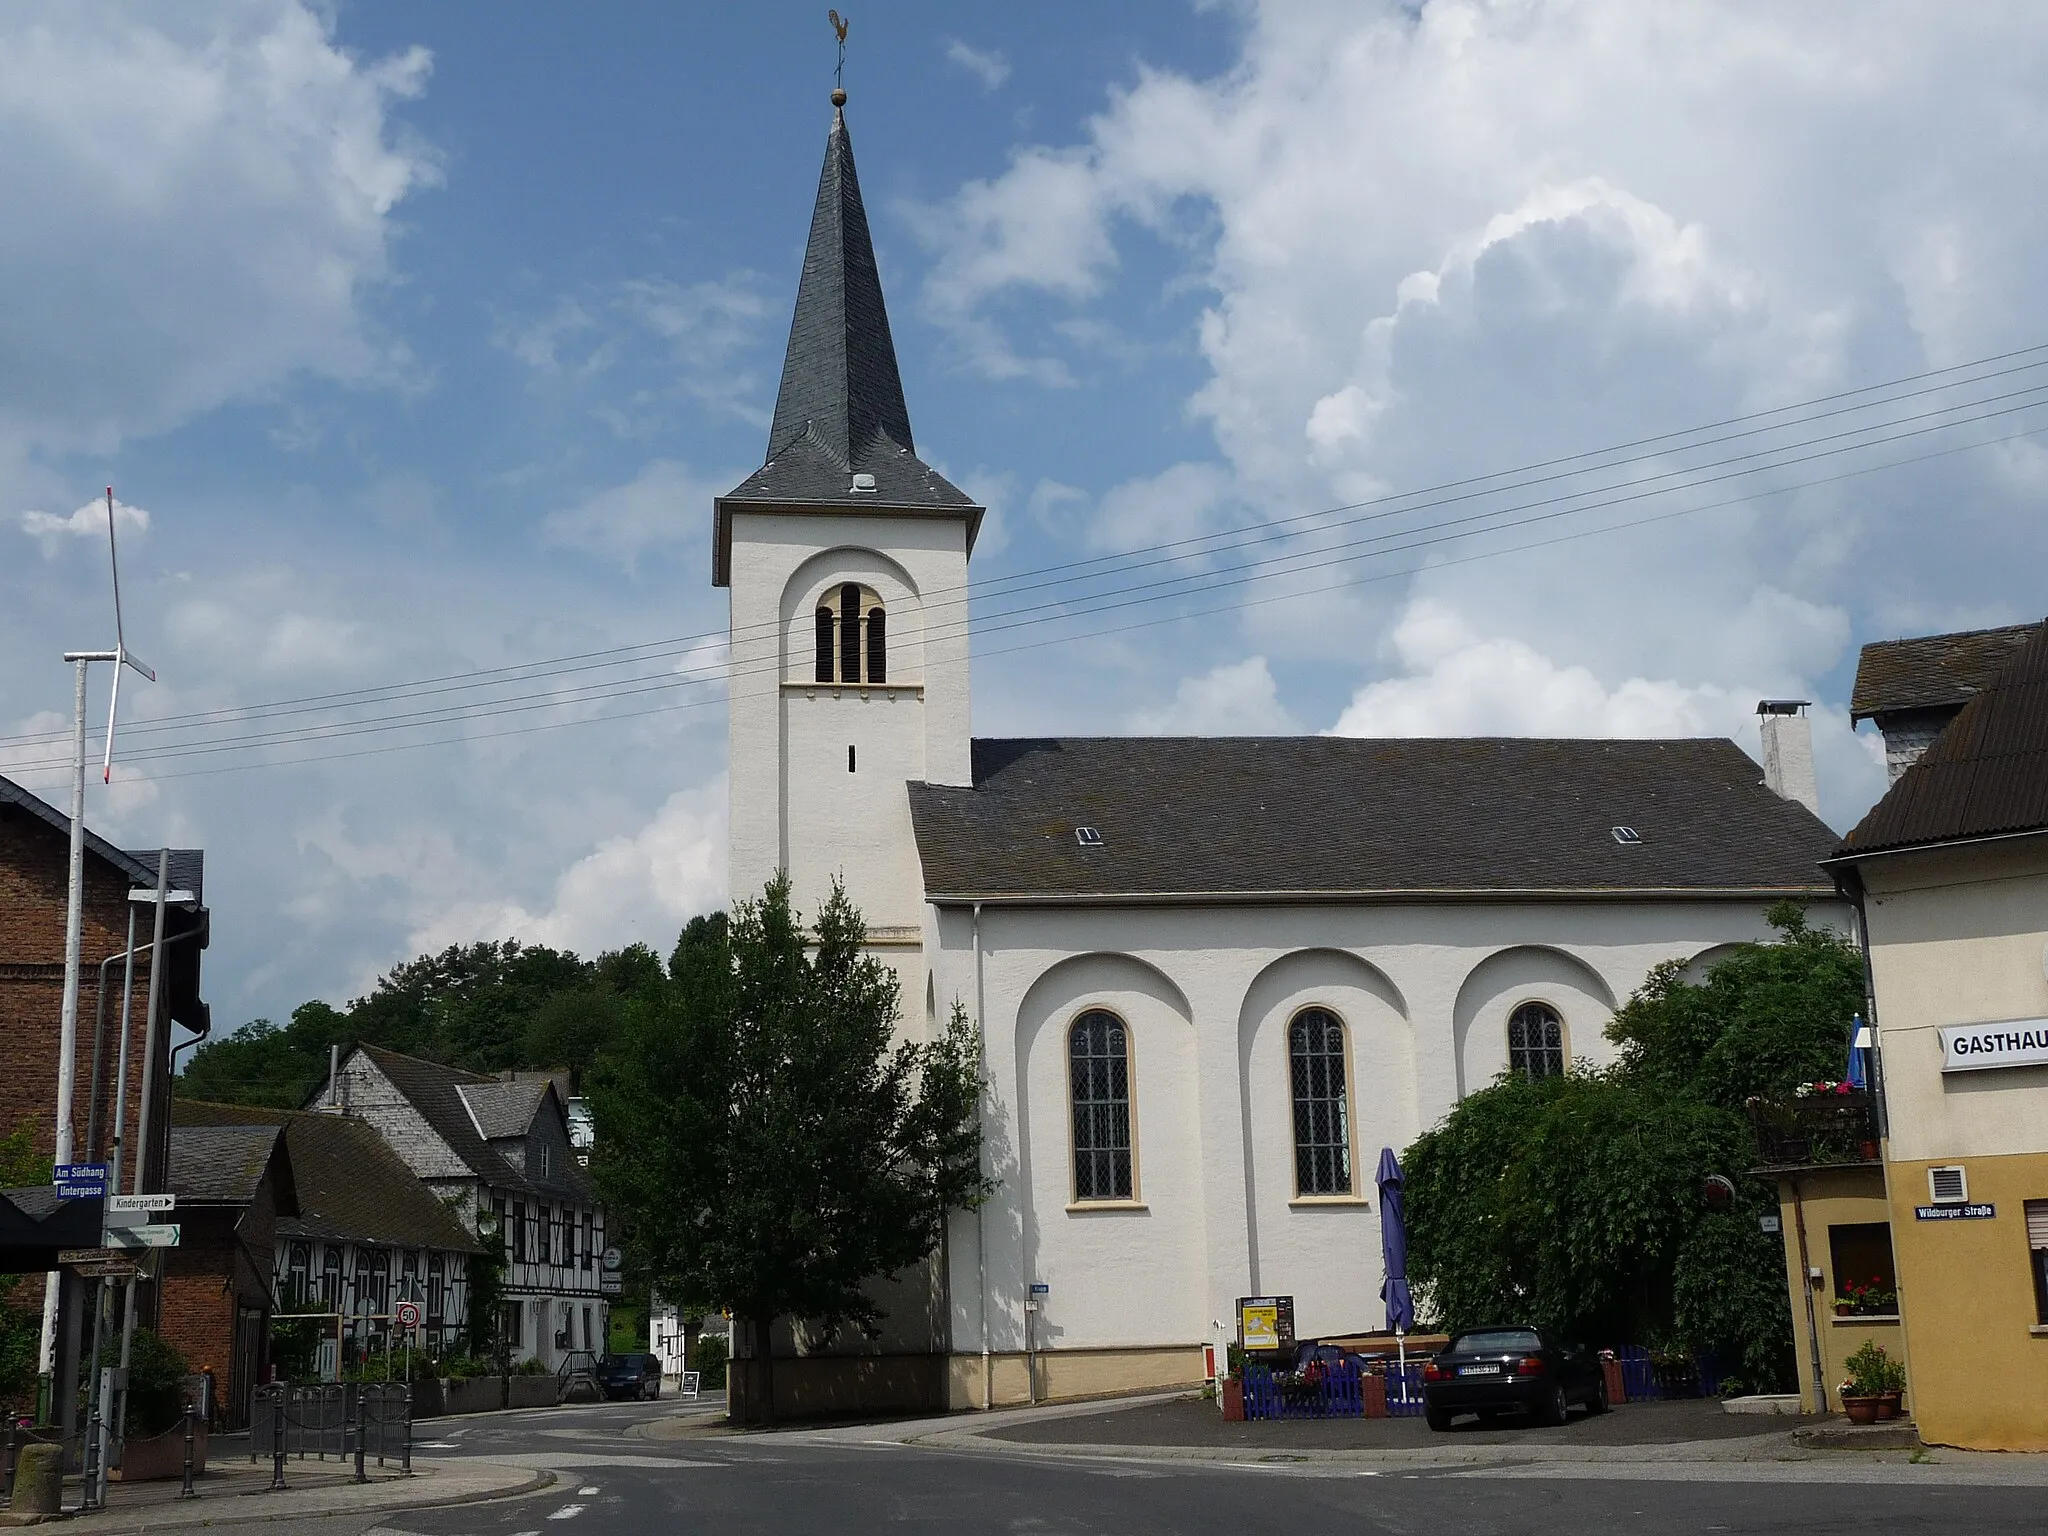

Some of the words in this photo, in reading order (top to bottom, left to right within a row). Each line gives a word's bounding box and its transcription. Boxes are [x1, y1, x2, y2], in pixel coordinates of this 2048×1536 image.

[1953, 1029, 2048, 1055] GASTHAU
[55, 1167, 69, 1178] Am
[71, 1166, 105, 1179] Südhang
[60, 1185, 102, 1198] Untergasse
[116, 1198, 163, 1209] Kindergarten
[1918, 1208, 1962, 1218] Wildburger
[1964, 1205, 1992, 1217] Straße
[402, 1310, 414, 1321] 50
